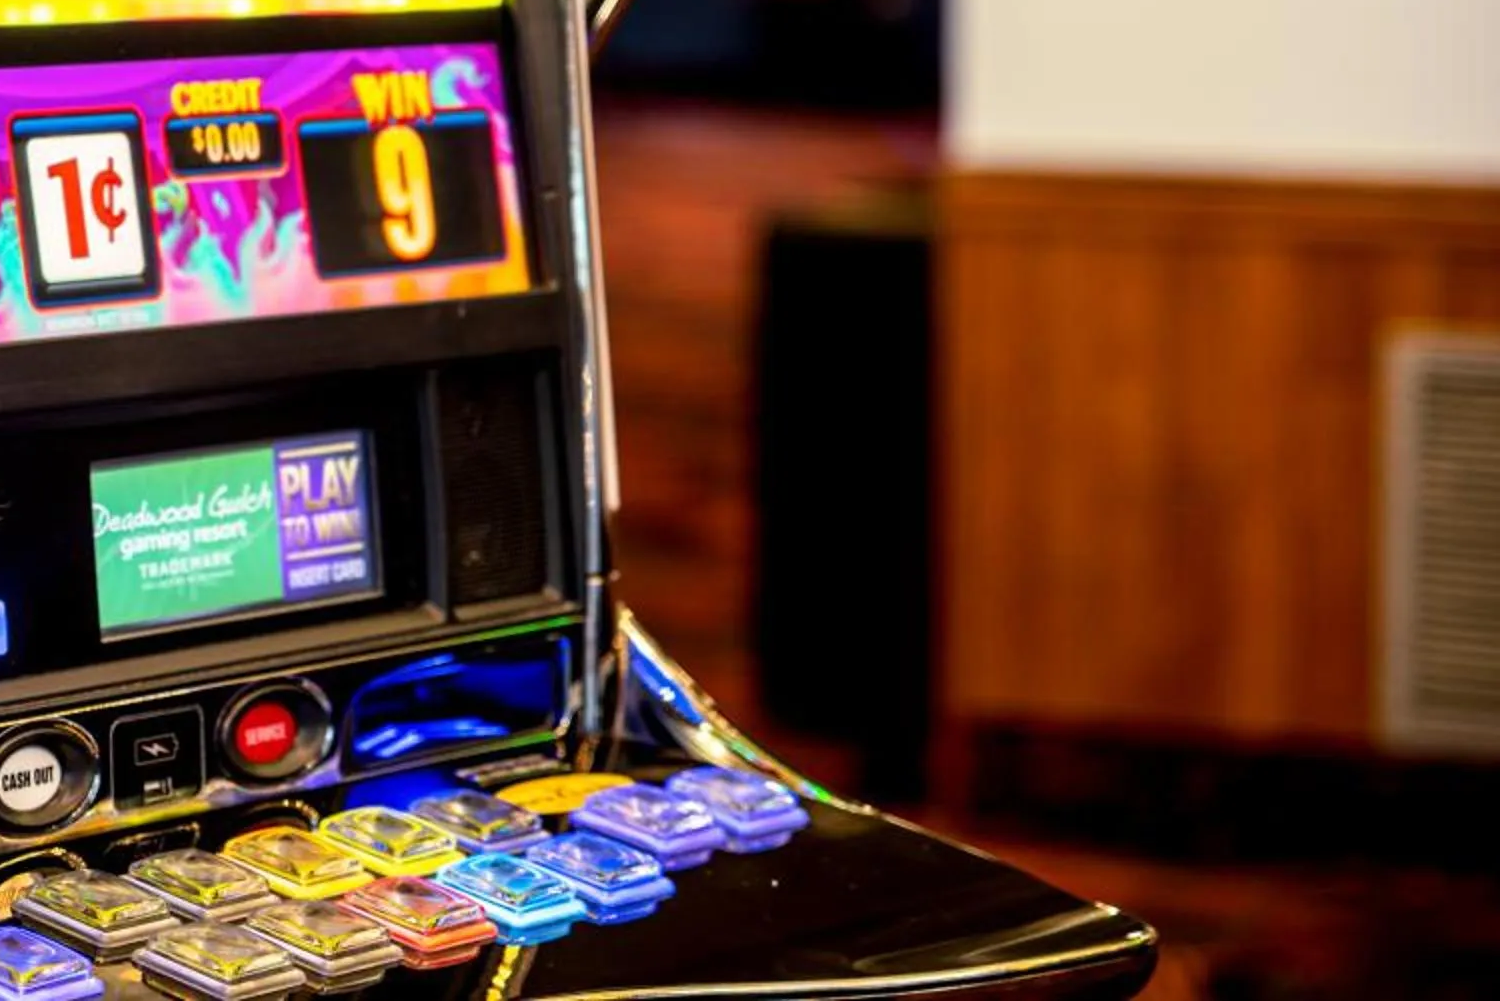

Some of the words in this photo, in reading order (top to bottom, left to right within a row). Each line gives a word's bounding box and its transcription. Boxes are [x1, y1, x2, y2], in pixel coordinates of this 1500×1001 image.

[170, 77, 262, 115] CREDIT
[352, 71, 433, 126] WIN
[192, 121, 261, 164] $0.00
[47, 155, 127, 261] 1¢
[373, 125, 435, 261] 9
[279, 456, 359, 514] PLAY
[92, 492, 205, 538] Deadwood
[208, 480, 272, 518] Gulch
[119, 528, 190, 561] gaming
[193, 519, 248, 544] resort
[281, 516, 309, 546] TO
[289, 565, 329, 589] INSERT
[332, 559, 366, 584] CARD
[1, 768, 32, 792] CASH
[33, 765, 54, 785] OUT
